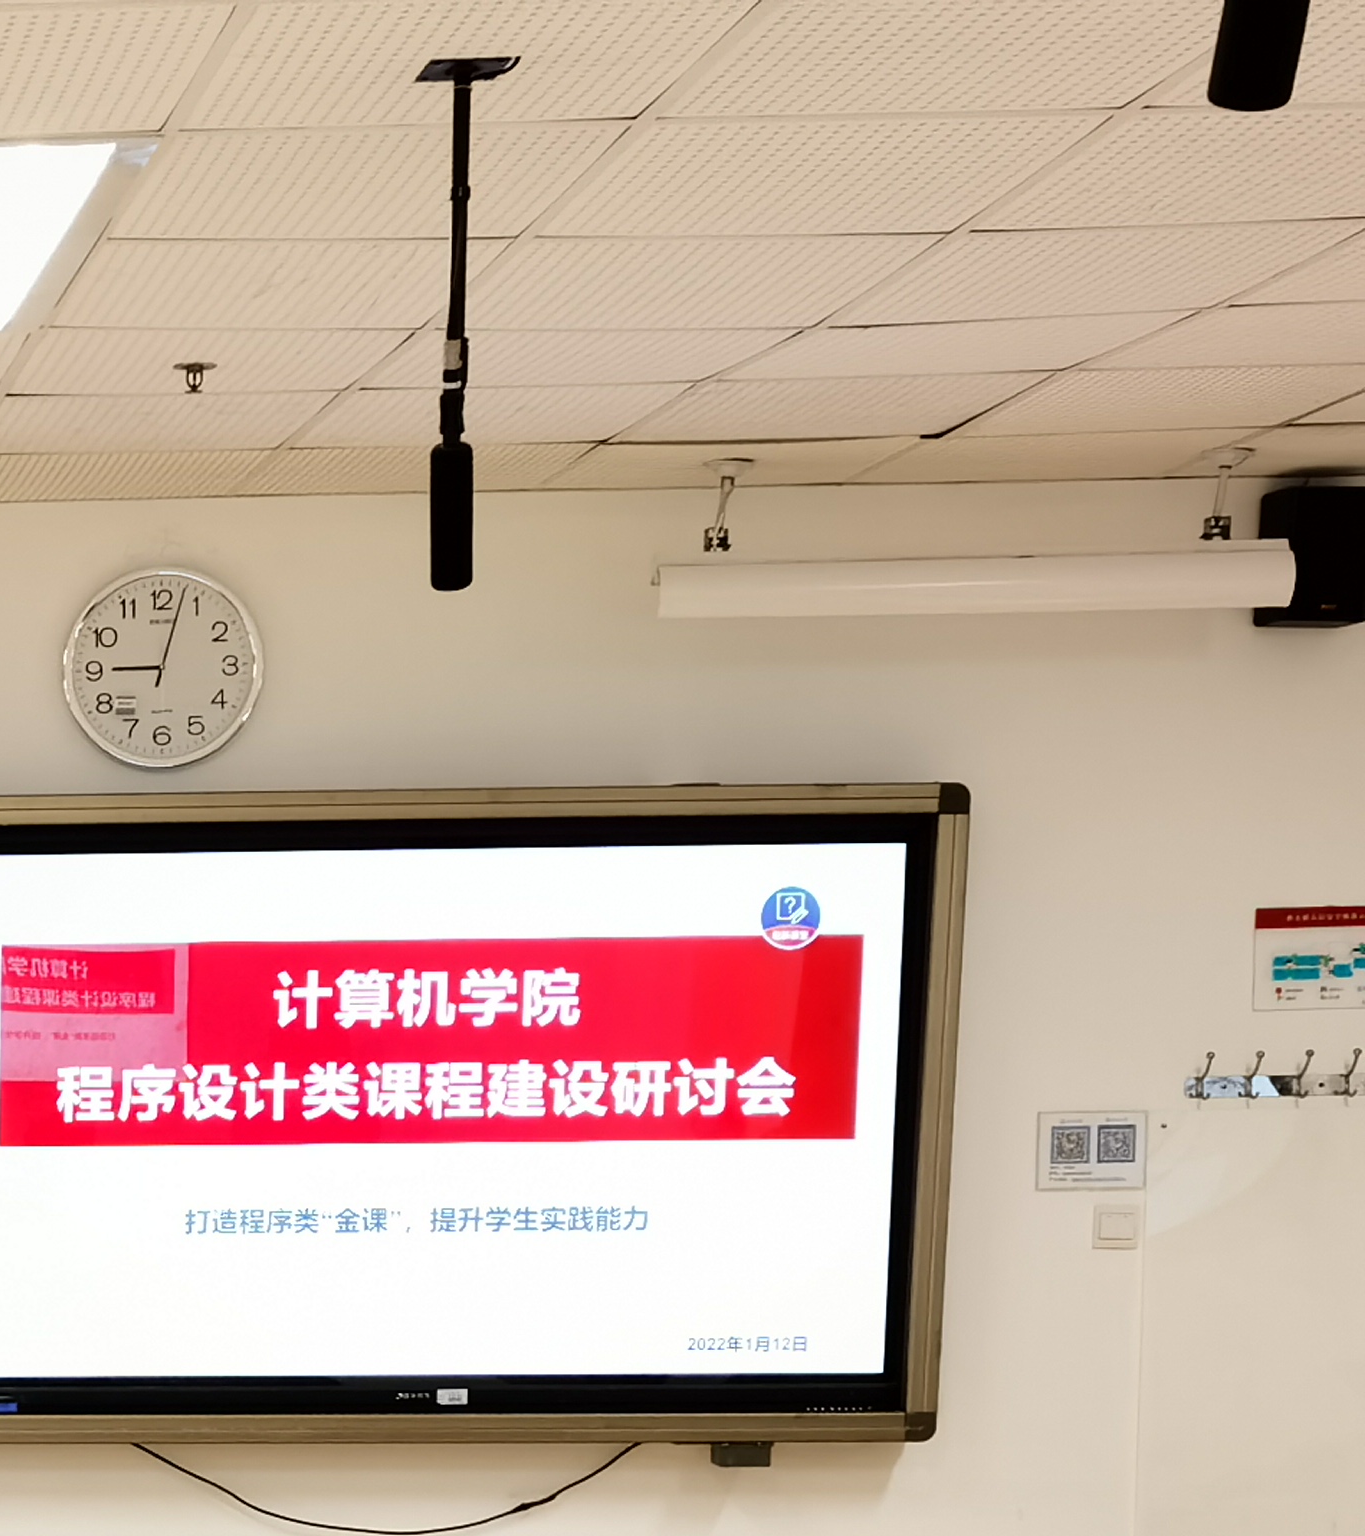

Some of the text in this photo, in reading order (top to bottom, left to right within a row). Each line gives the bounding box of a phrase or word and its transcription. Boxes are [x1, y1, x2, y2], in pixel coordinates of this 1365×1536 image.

[119, 597, 137, 619] 11
[150, 589, 173, 611] 12
[192, 596, 200, 616] 1
[93, 626, 118, 648] 10
[211, 621, 229, 643] 2
[85, 660, 103, 682] 9
[222, 654, 239, 677] 3
[95, 692, 114, 714] 8
[210, 688, 228, 710] 4
[122, 718, 140, 739] 7
[152, 725, 172, 746] 6
[187, 715, 205, 736] 5
[273, 967, 582, 1029] 计算机学院
[56, 1055, 797, 1124] 程序设计类课程建设研讨会
[687, 1336, 808, 1353] 2022年1月12日
